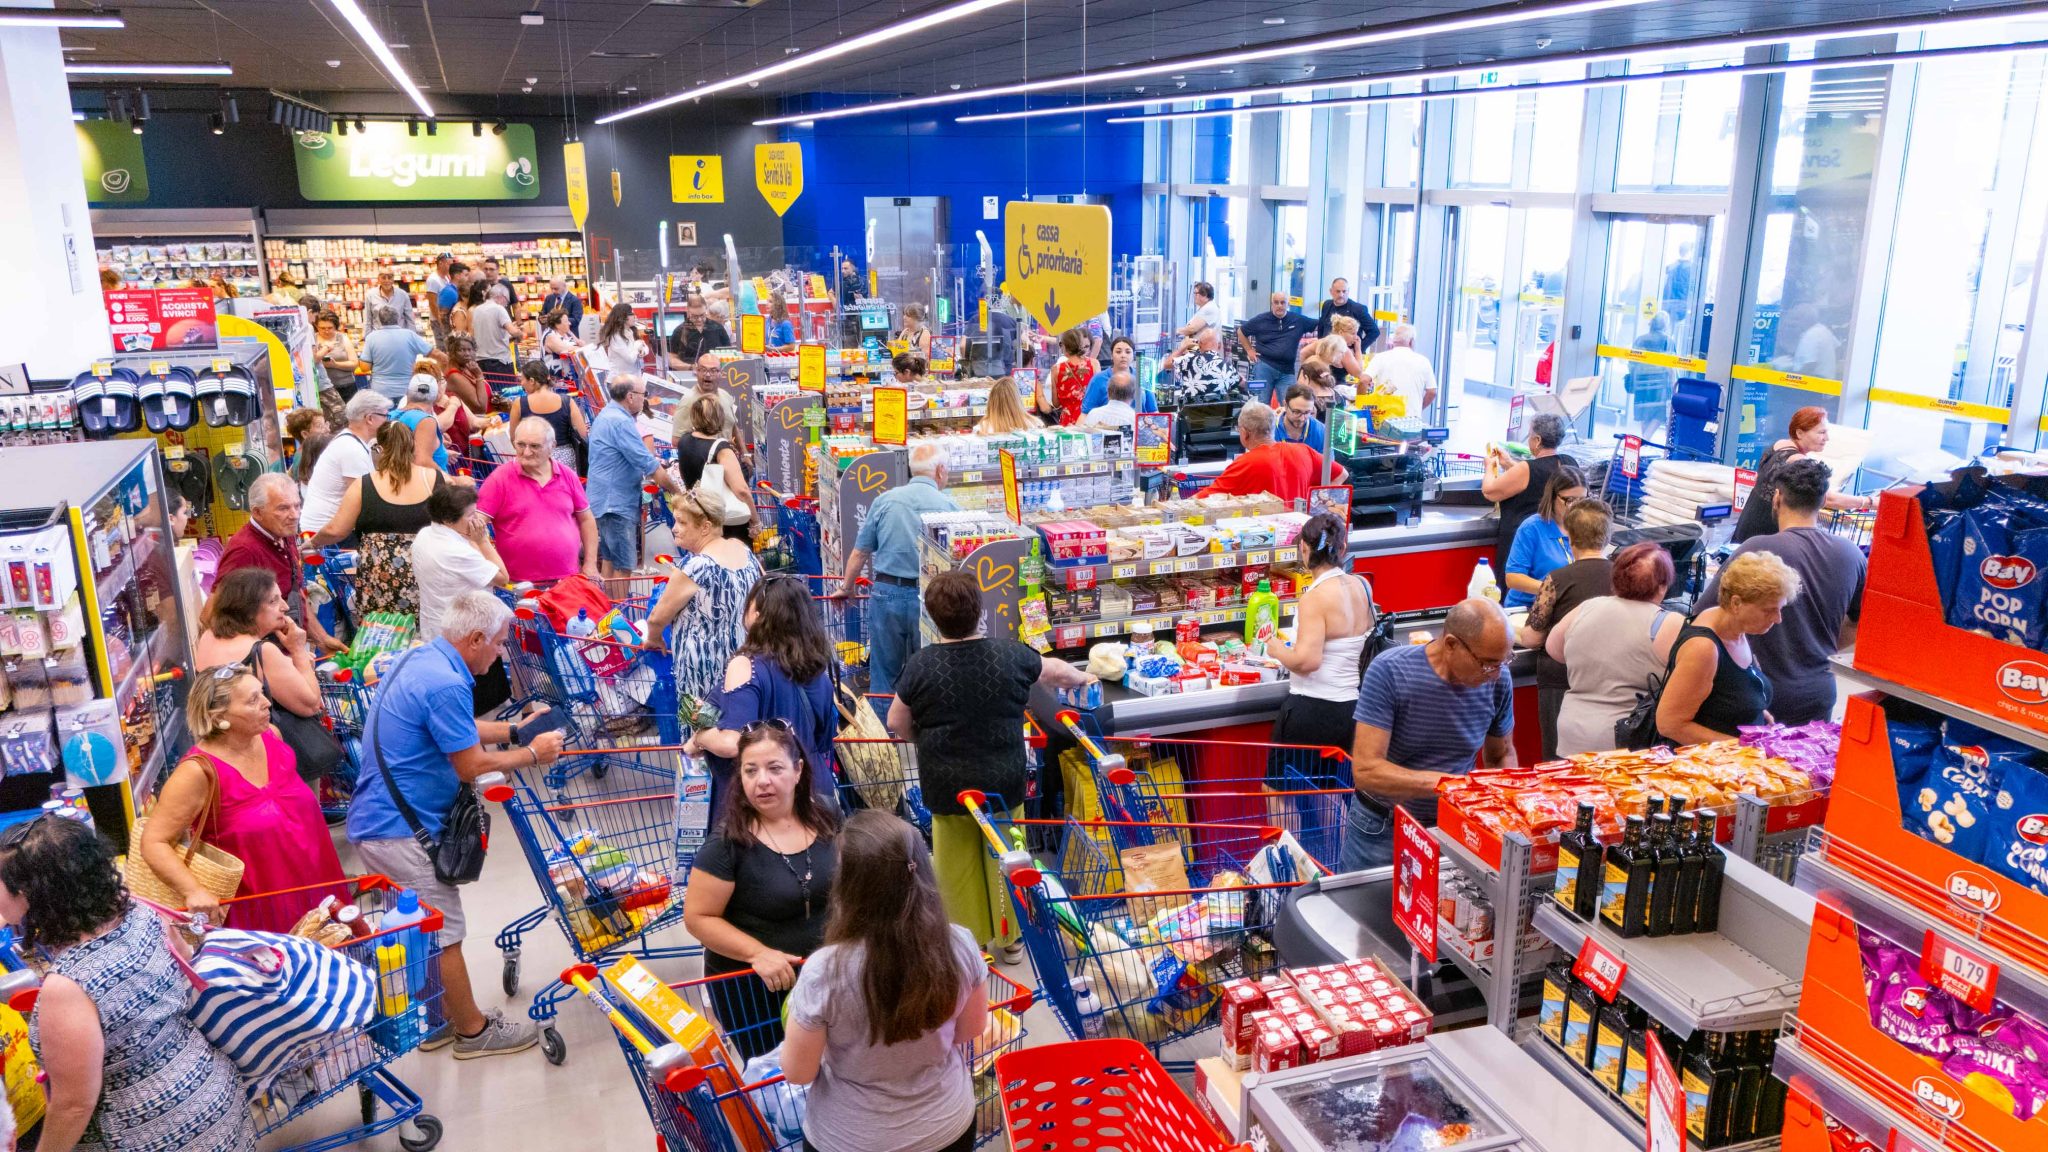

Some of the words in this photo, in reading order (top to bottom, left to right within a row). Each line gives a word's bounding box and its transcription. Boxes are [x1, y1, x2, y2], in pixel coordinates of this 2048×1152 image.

[349, 150, 486, 187] Legumi
[1036, 224, 1060, 242] cassa
[1036, 246, 1083, 275] prioritaria
[161, 302, 209, 311] ACQUISTA
[162, 310, 197, 318] &VINCI!
[1786, 373, 1802, 381] SUPER
[1338, 421, 1347, 442] 4
[1284, 552, 1295, 560] 2.19
[1983, 559, 2032, 584] Bay
[1981, 586, 2023, 614] POP
[1104, 625, 1116, 634] 1.00
[1974, 604, 2028, 635] CORN
[0, 624, 19, 648] 7
[21, 630, 41, 650] 8
[51, 620, 68, 642] 9
[2002, 668, 2048, 697] Bay
[1997, 700, 2019, 714] chips
[2020, 707, 2026, 715] &
[685, 782, 708, 794] General
[1402, 823, 1433, 860] offerta
[1950, 875, 1997, 909] Bay
[1600, 961, 1617, 981] 8.50
[1953, 956, 1984, 983] 0.79
[1584, 970, 1607, 992] offerta
[1941, 973, 1970, 991] prezzi
[1941, 982, 1968, 1000] fermi
[1917, 1079, 1961, 1117] Bay
